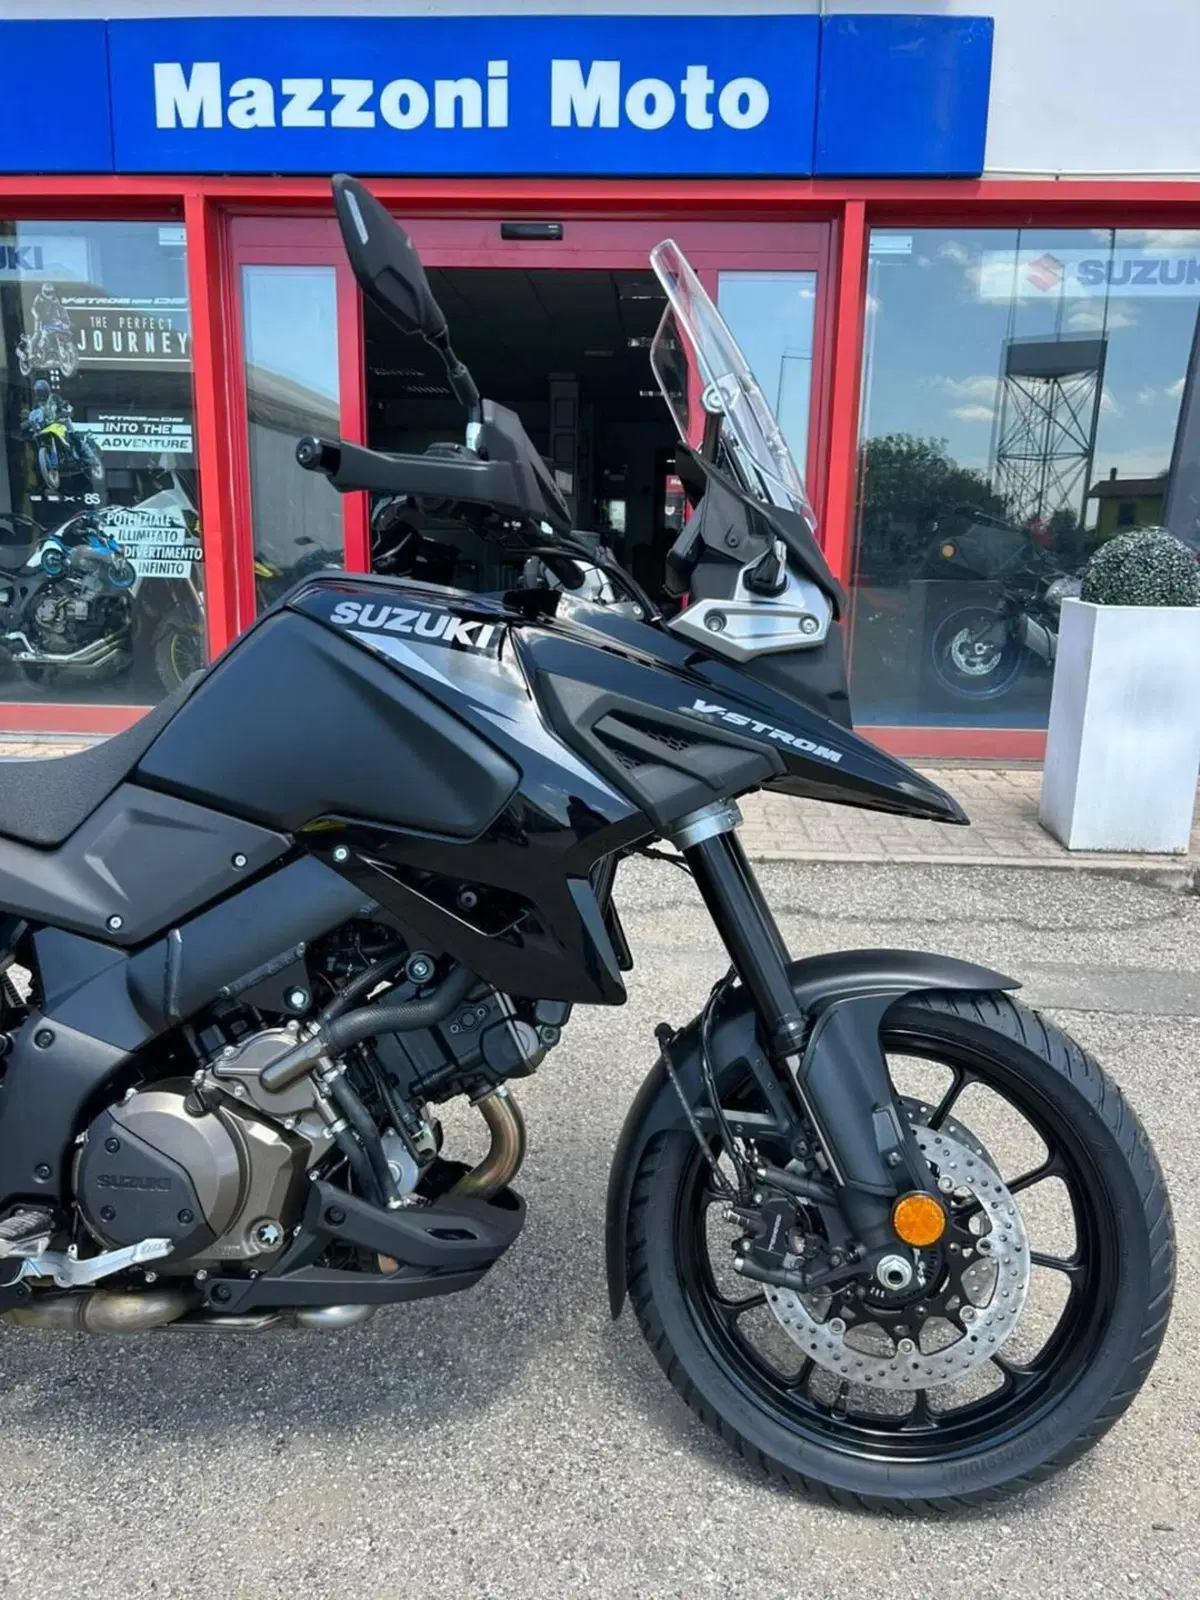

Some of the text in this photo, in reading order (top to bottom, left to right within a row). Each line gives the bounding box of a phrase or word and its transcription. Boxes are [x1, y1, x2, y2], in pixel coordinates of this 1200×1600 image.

[153, 59, 770, 130] Mazzoni Moto
[0, 246, 44, 270] KI
[90, 316, 172, 331] THE PERFECT
[77, 329, 187, 354] JOURNEY
[105, 422, 171, 434] INTO THE
[101, 438, 188, 449] ADVENTURE
[118, 529, 178, 542] ILLIMITATO
[124, 545, 203, 560] DIVERTIMENTO
[138, 562, 184, 574] INFINITO
[330, 601, 496, 648] SUZUKI
[692, 699, 843, 763] V-STROM
[97, 1173, 172, 1192] SUZUKI
